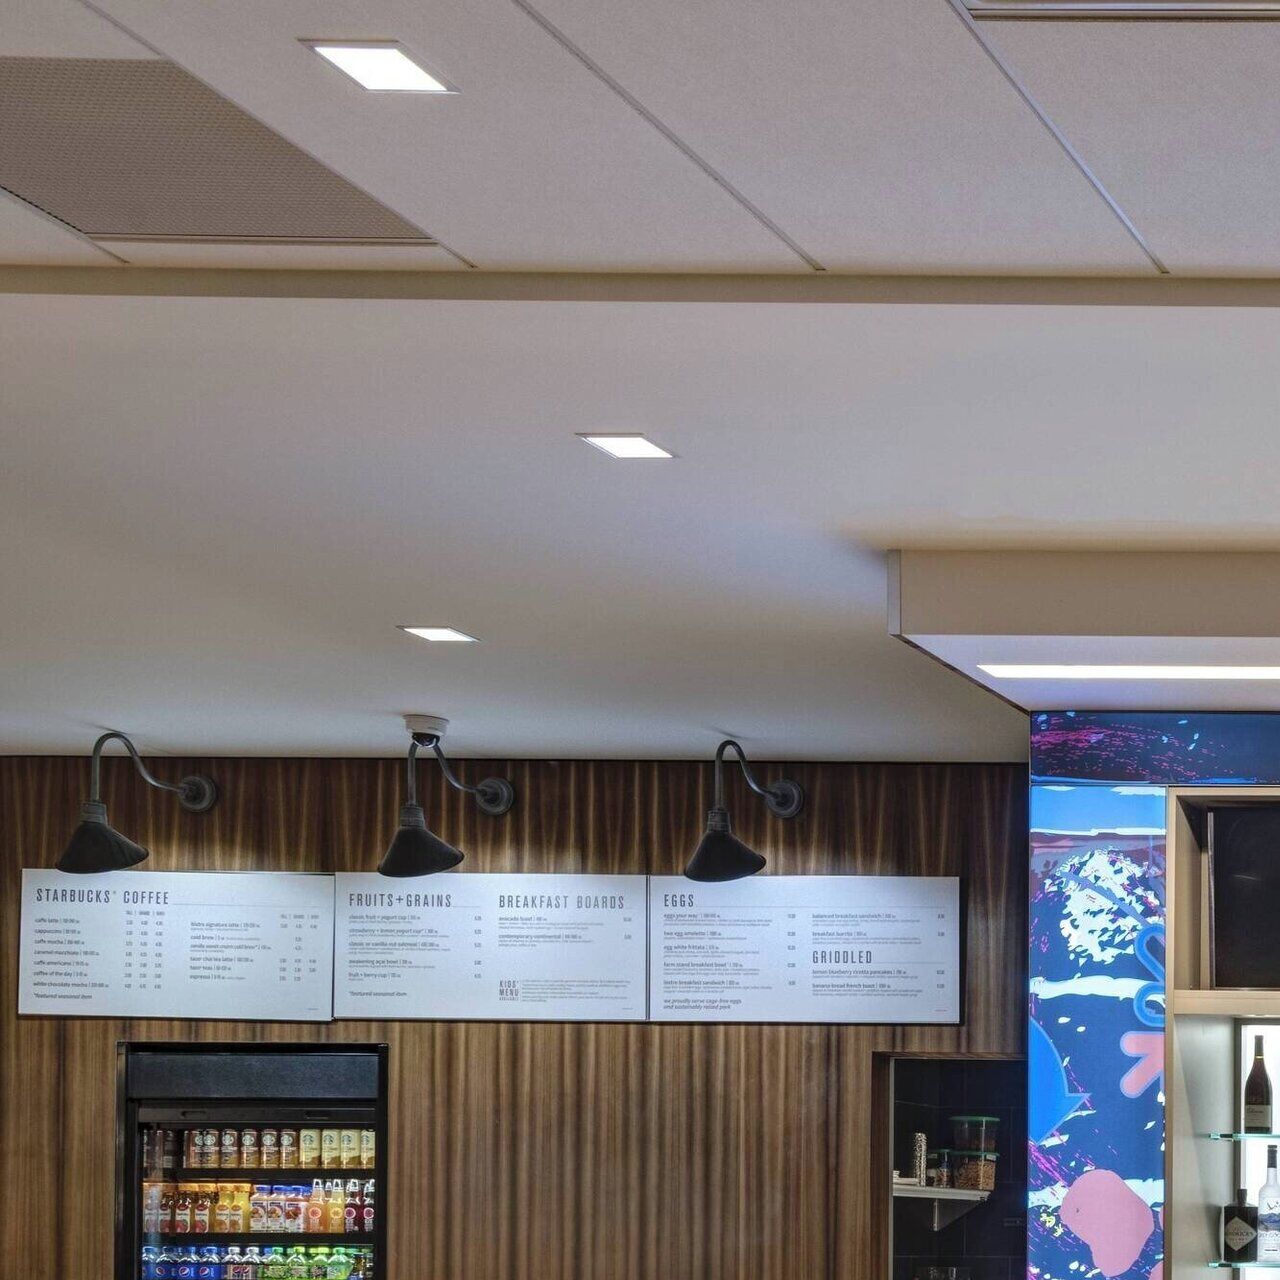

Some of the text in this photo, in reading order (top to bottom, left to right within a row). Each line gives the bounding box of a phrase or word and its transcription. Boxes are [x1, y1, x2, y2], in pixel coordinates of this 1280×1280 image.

[36, 888, 169, 905] STARBUCKS COFFEE
[499, 895, 625, 910] BREAKFAST BOARDS
[664, 894, 694, 908] EGGS
[812, 950, 872, 964] GRIDDLED
[499, 988, 519, 996] MENU
